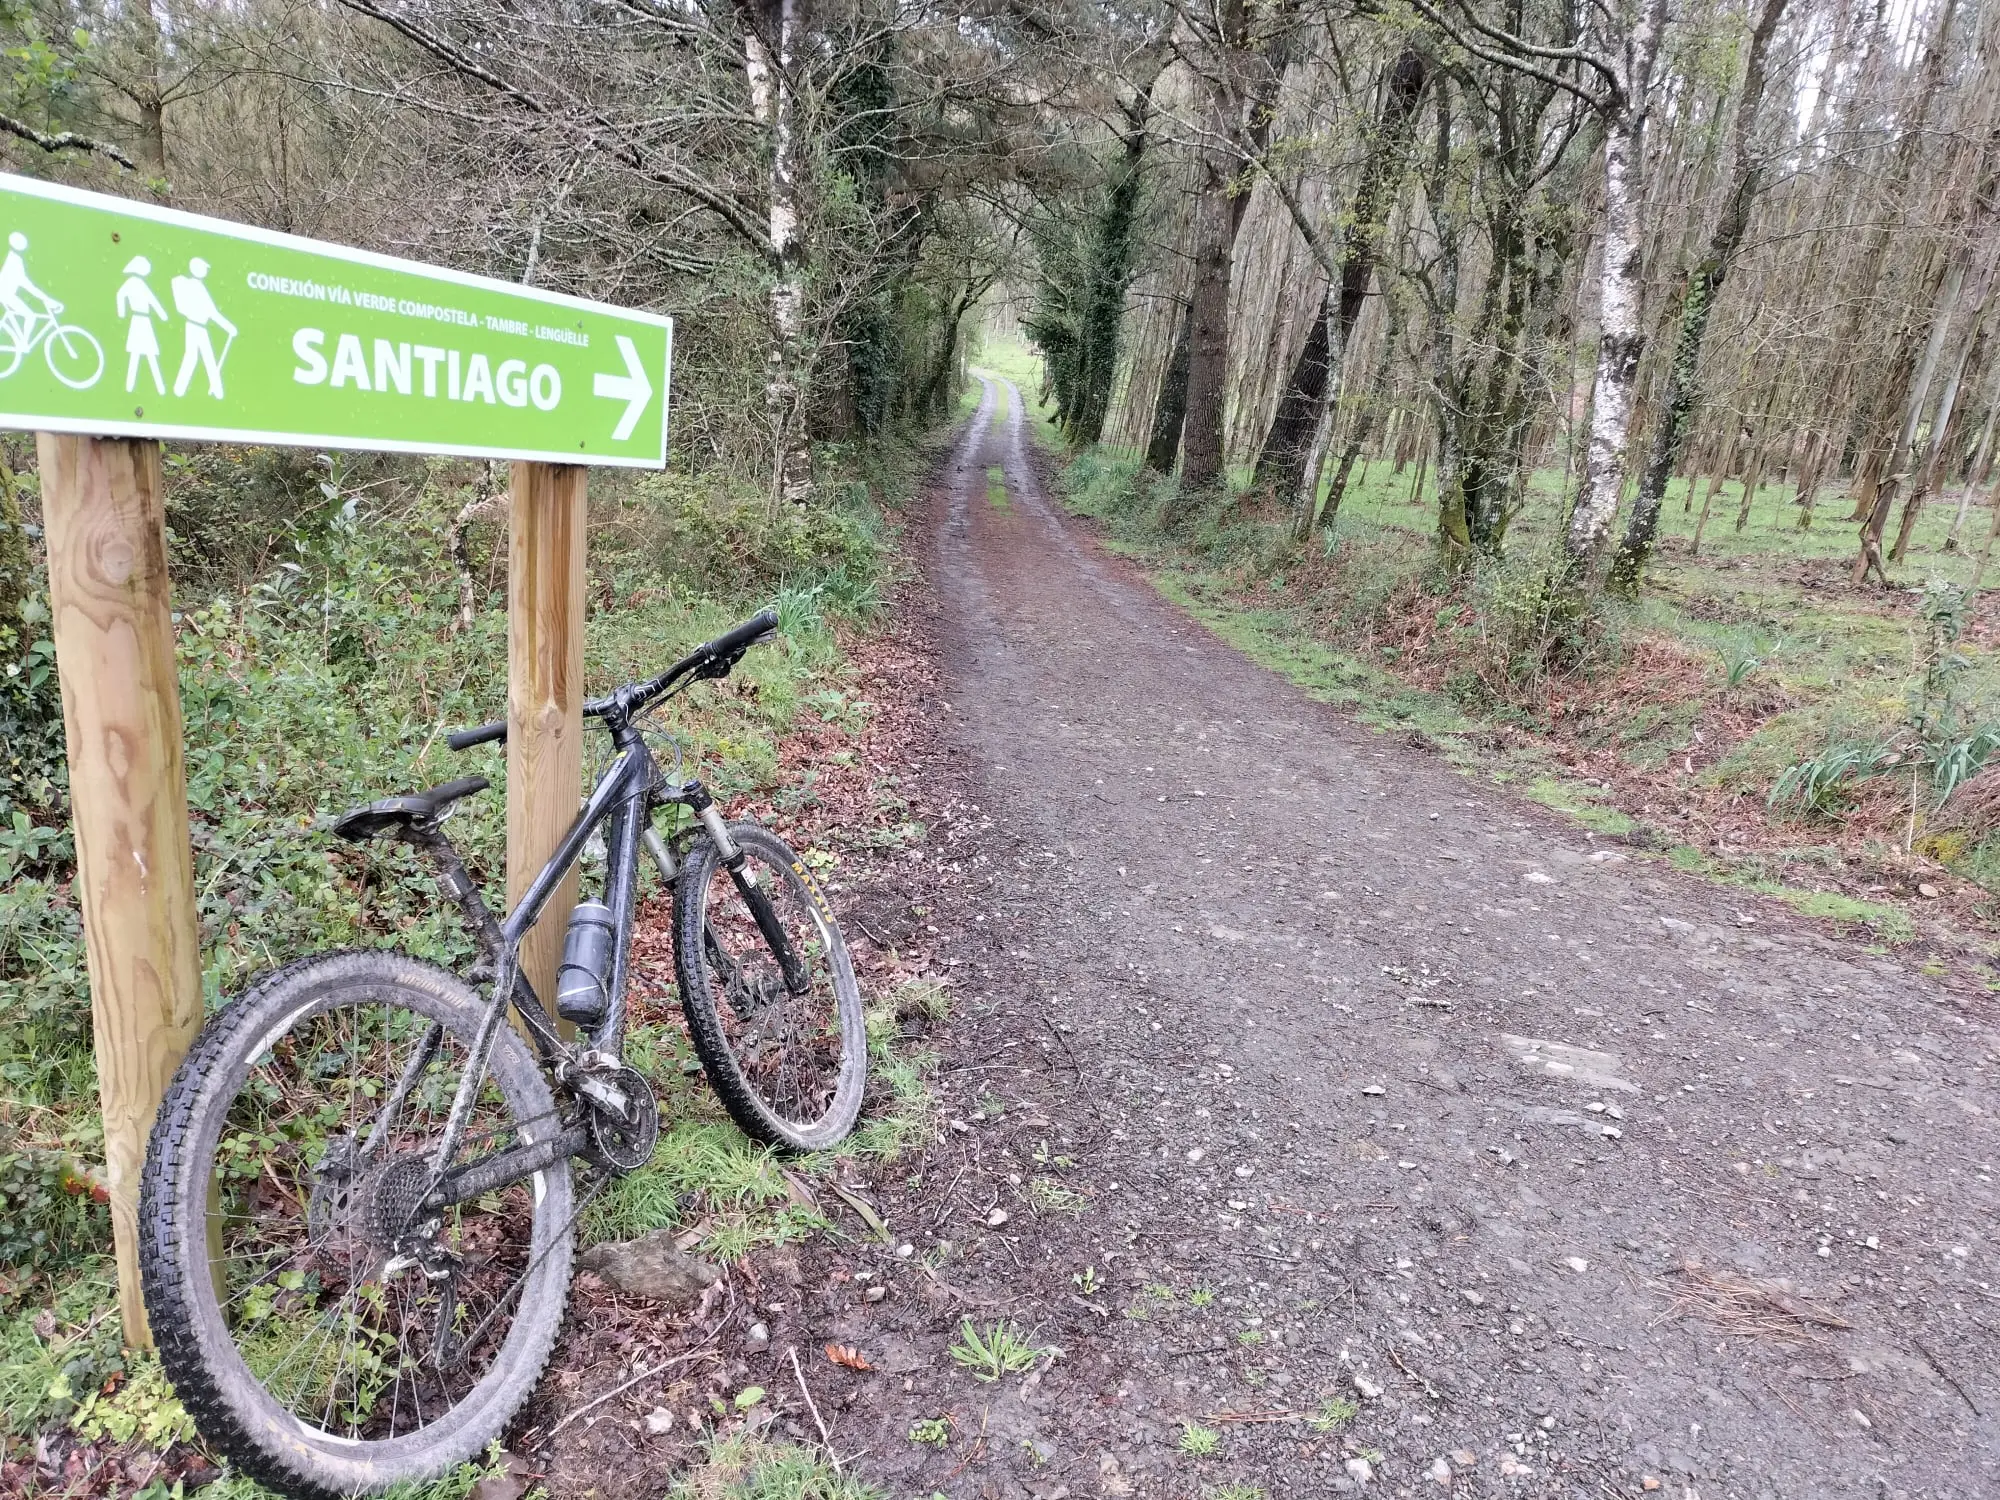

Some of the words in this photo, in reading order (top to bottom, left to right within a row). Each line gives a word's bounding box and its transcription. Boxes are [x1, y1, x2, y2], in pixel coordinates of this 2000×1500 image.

[247, 271, 326, 301] CONEXIÓN
[327, 284, 352, 305] VÍA
[353, 290, 397, 313] VERDE
[398, 299, 479, 328] COMPOSTELA
[485, 315, 529, 337] TAMBRE
[293, 328, 562, 411] SANTIAGO
[791, 861, 834, 924] MAXXIS
